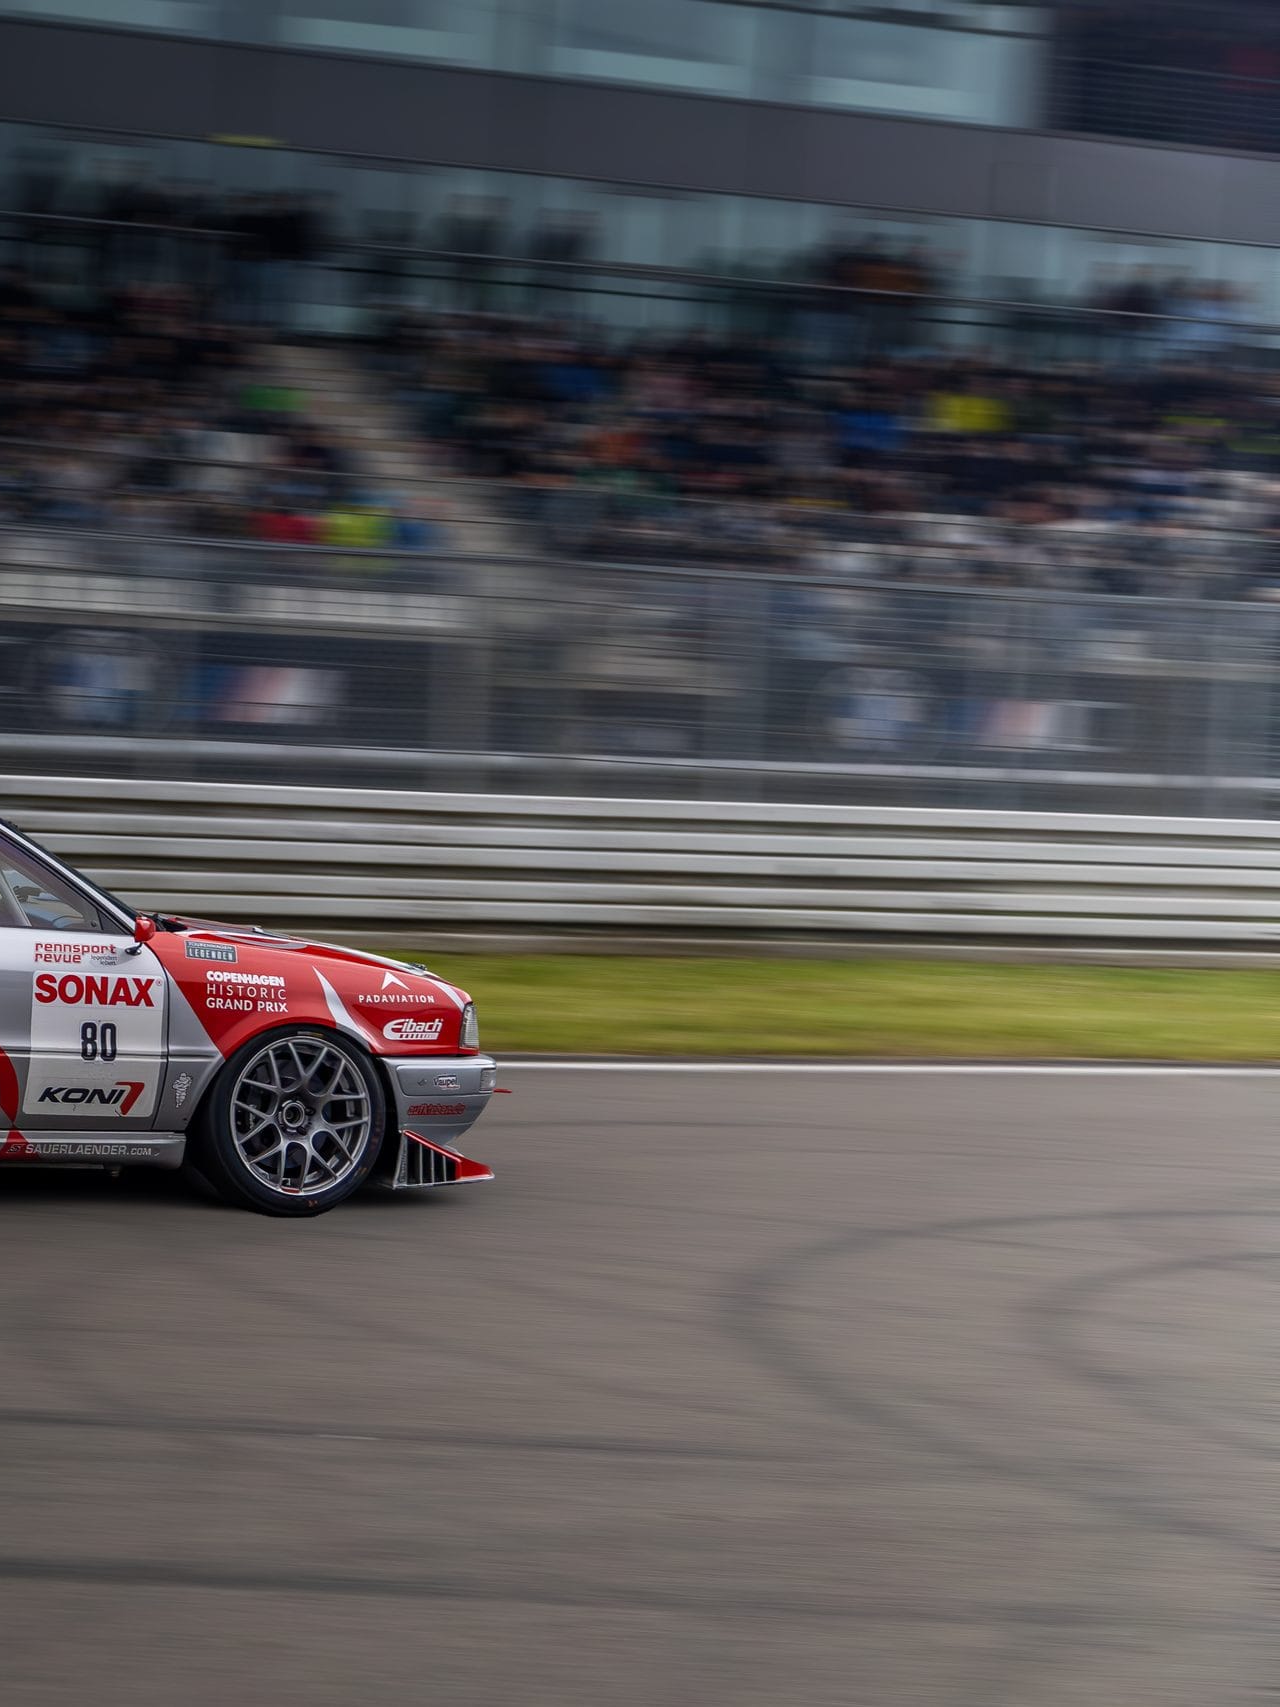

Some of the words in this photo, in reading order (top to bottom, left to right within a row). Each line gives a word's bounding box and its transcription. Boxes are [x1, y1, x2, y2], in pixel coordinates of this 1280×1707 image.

[35, 942, 117, 956] rennsport
[189, 948, 233, 961] LEGENDEN
[35, 953, 82, 964] revue
[206, 970, 285, 987] COPENHAGEN
[34, 973, 155, 1008] SONAX
[206, 983, 287, 1000] HISTORIC
[206, 997, 253, 1012] GRAND
[257, 1000, 288, 1013] PRIX
[358, 994, 435, 1004] PADAVIATION
[382, 1018, 443, 1040] Eibach
[80, 1021, 118, 1062] 80
